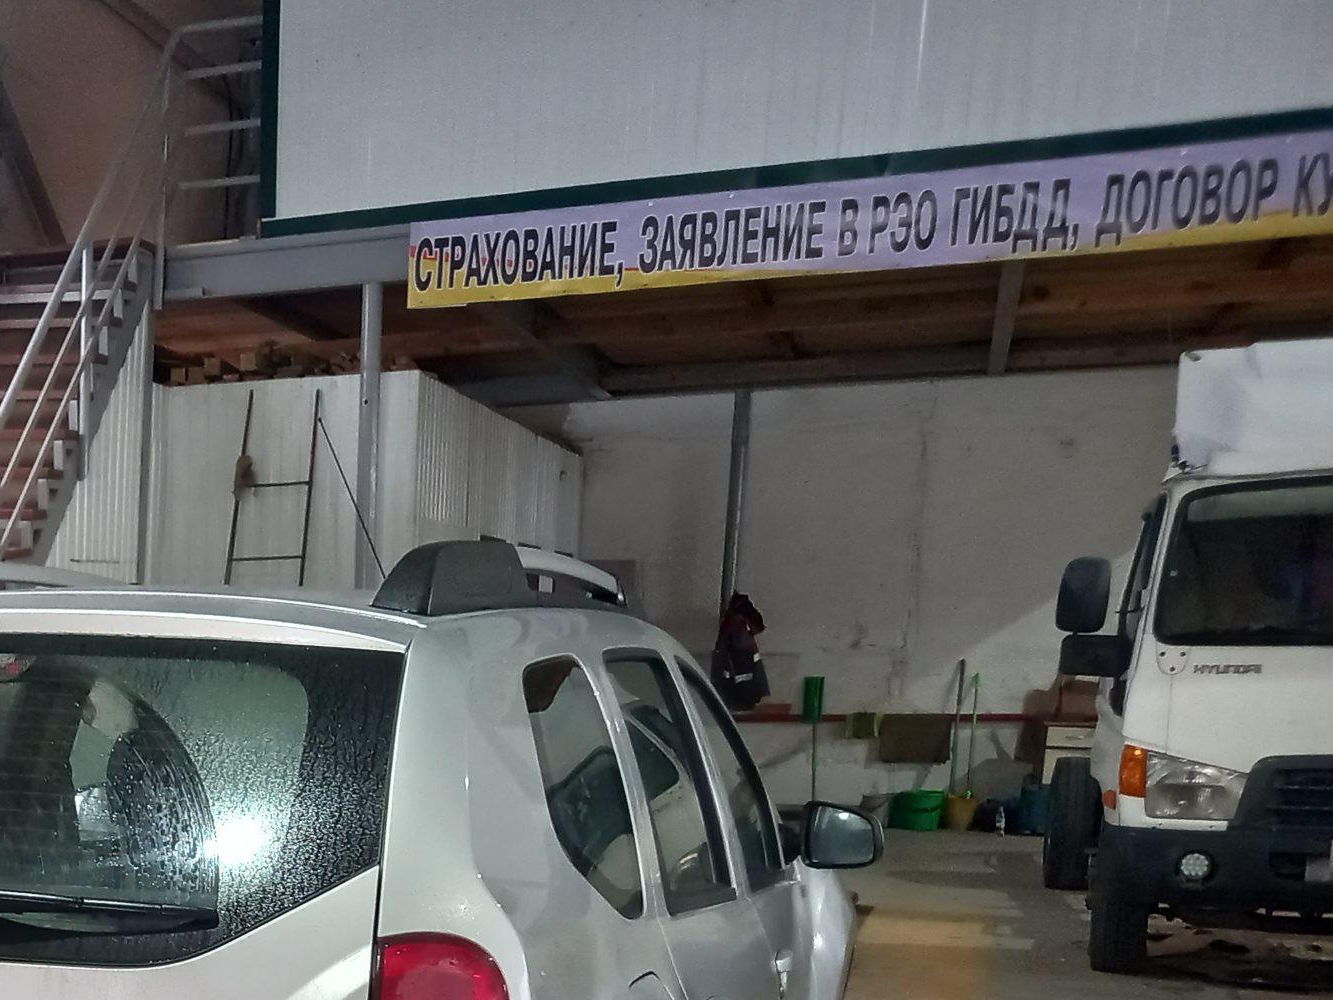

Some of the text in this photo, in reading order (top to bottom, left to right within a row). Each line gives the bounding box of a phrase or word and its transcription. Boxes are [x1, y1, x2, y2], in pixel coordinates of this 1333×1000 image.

[414, 220, 625, 292] СТРАХОВАНИЕ,
[638, 200, 827, 275] ЗАЯВЛЕНИЕ
[836, 198, 860, 258] В
[868, 188, 939, 255] РЭО
[949, 178, 1079, 253] ГИБДД,
[1094, 157, 1279, 248] ДОГОВОР
[1193, 664, 1263, 675] HYUNDAI
